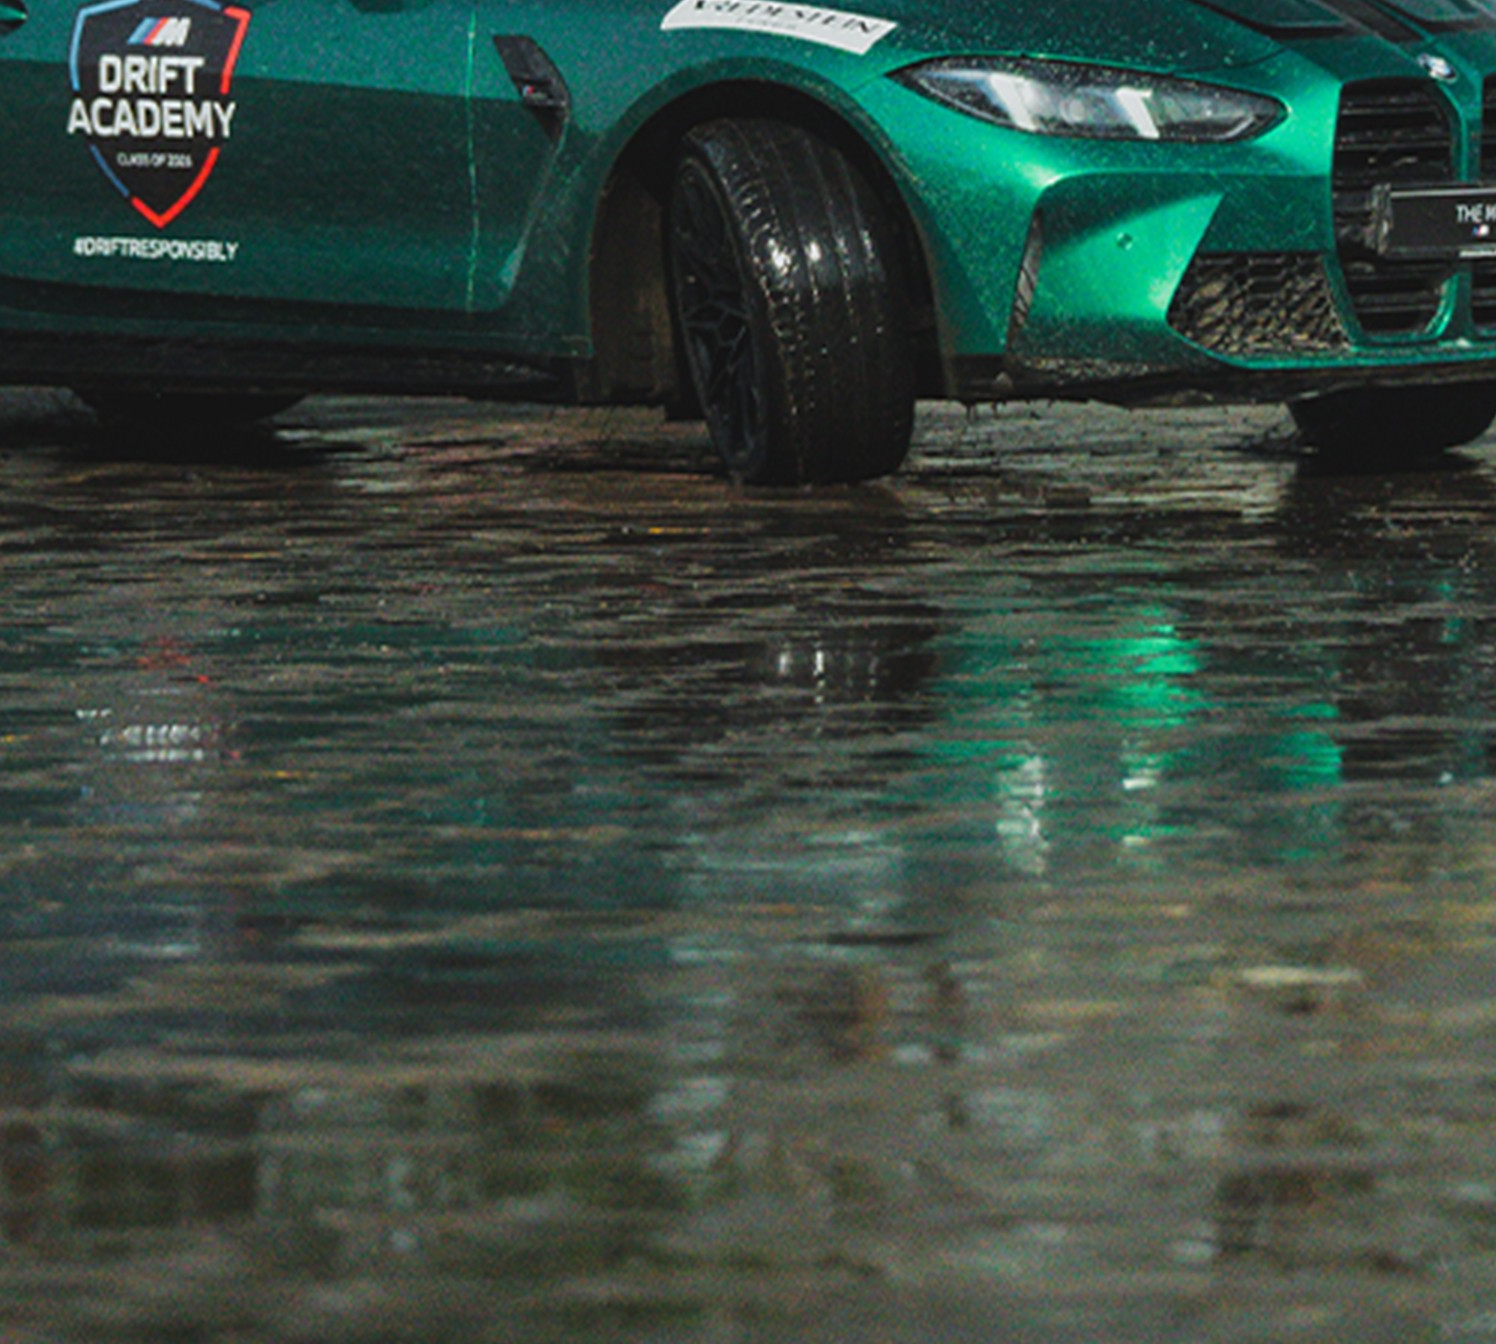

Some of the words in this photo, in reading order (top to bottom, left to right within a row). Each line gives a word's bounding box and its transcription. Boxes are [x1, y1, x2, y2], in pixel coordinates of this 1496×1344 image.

[98, 54, 205, 95] DRIFT
[66, 98, 236, 139] ACADEMY
[1456, 203, 1483, 222] THE
[73, 236, 239, 260] #DRIFTRESPONSIBLY
